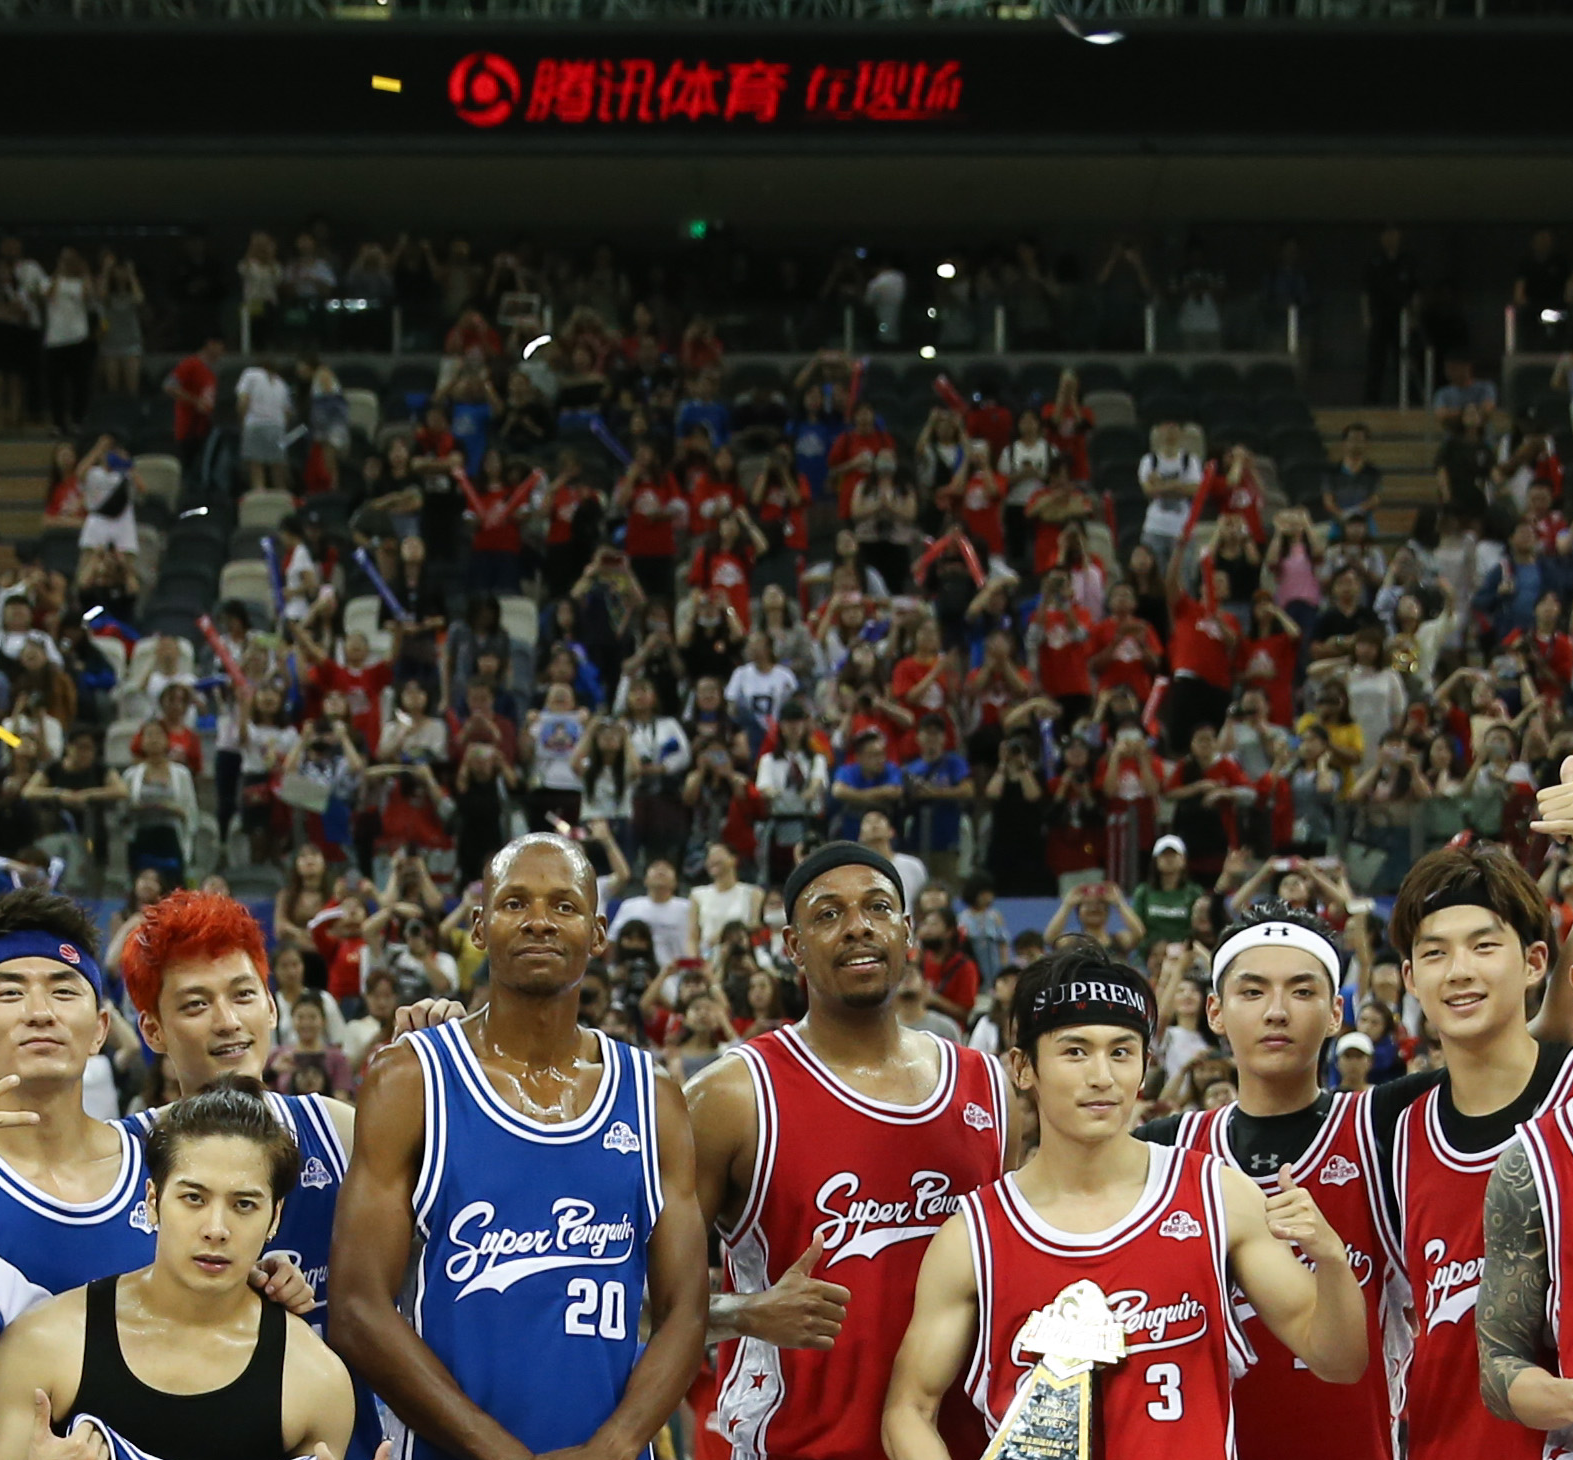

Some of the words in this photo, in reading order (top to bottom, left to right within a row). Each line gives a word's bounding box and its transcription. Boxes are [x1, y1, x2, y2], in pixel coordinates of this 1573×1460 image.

[525, 58, 790, 122] 腾讯体育
[1033, 981, 1147, 1015] SUPREM
[446, 1201, 553, 1283] Super
[551, 1197, 634, 1257] Penguin
[813, 1172, 912, 1250] Super
[564, 1277, 626, 1341] 20
[1106, 1289, 1208, 1342] Penguin
[1144, 1362, 1185, 1421] 3
